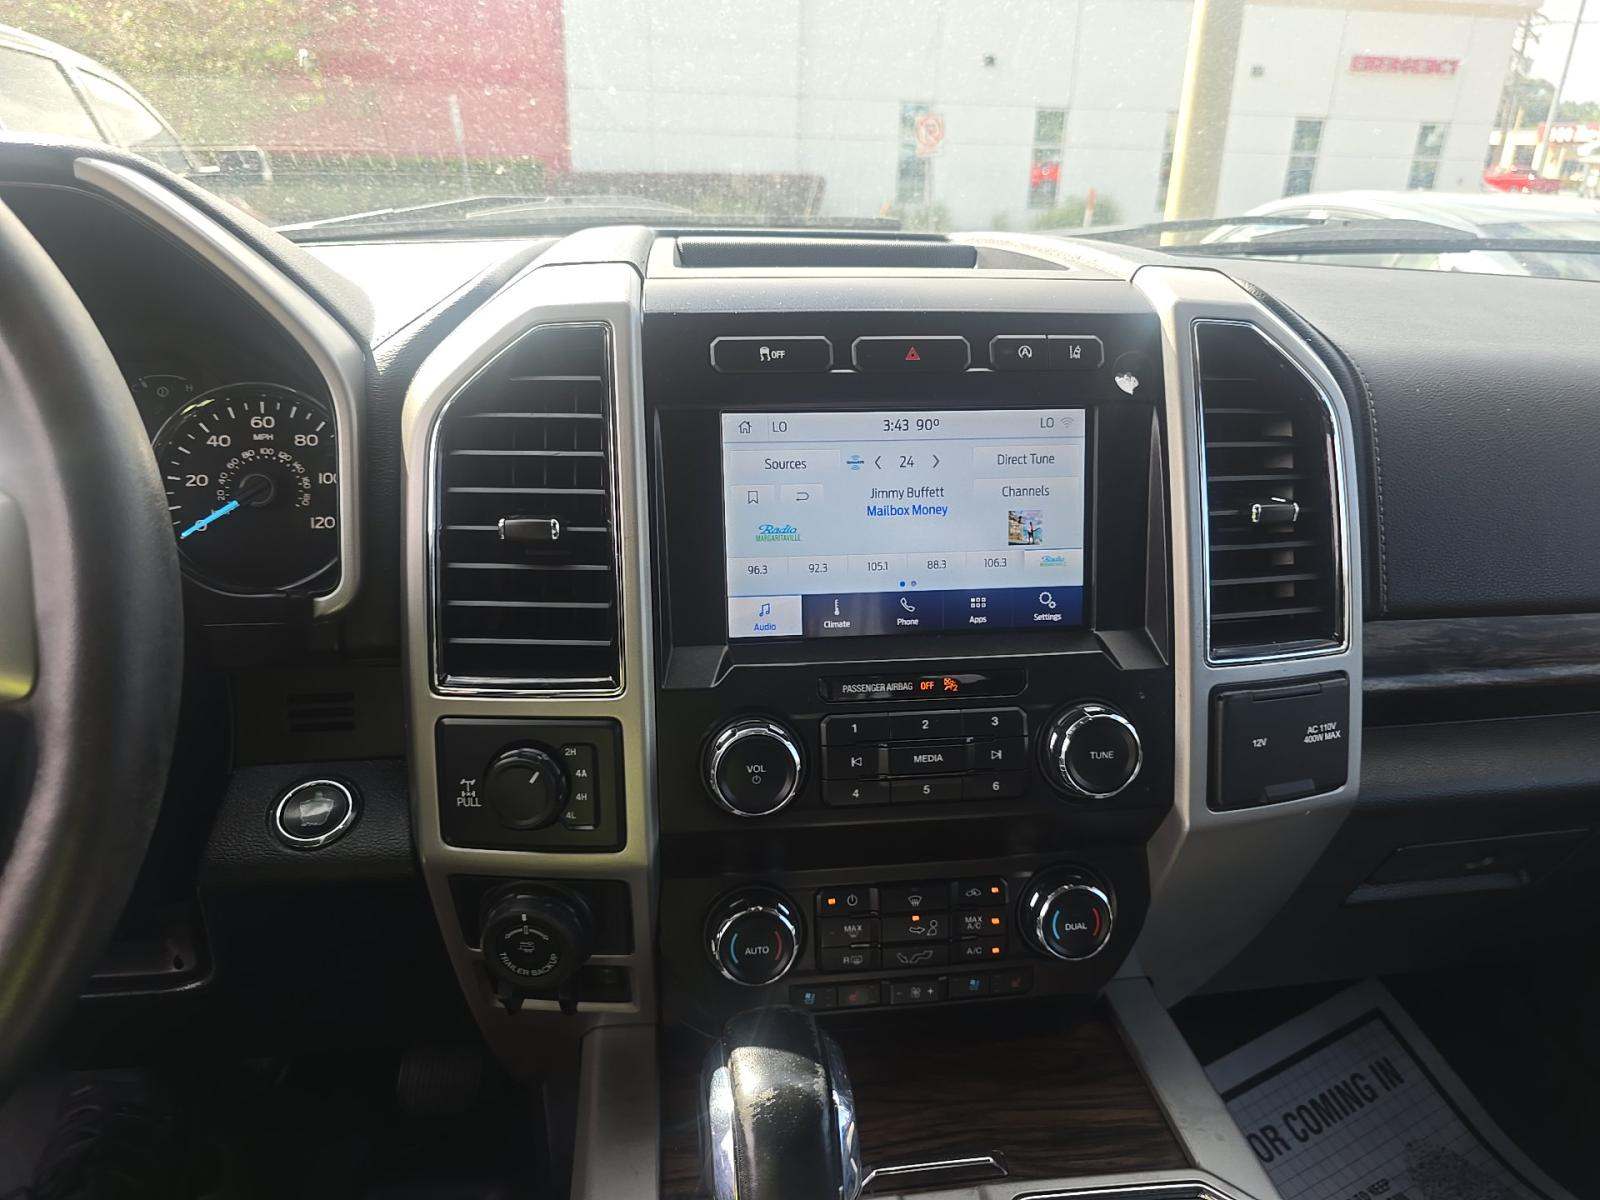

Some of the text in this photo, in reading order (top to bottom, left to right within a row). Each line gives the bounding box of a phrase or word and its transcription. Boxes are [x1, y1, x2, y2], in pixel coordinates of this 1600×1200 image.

[770, 349, 785, 359] OFF
[184, 384, 194, 392] H
[250, 416, 275, 428] 60
[772, 421, 788, 433] LO
[883, 418, 909, 432] 3:43
[1040, 417, 1055, 429] LO
[206, 435, 231, 447] 40
[252, 433, 274, 441] MPH
[294, 434, 319, 447] 80
[241, 449, 255, 459] 80
[260, 447, 275, 455] 100
[278, 451, 293, 461] 120
[226, 457, 239, 469] 60
[764, 457, 807, 470] Sources
[899, 455, 914, 468] 24
[997, 452, 1055, 466] Direct Tune
[185, 474, 209, 487] 20
[218, 472, 228, 485] 40
[216, 489, 225, 501] 20
[870, 486, 945, 501] Jimmy Buffett
[1001, 484, 1050, 497] Channels
[866, 503, 949, 518] Mailbox Money
[310, 517, 336, 529] 120
[758, 523, 798, 534] Radio
[808, 562, 828, 573] 92.3
[867, 561, 889, 572] 105.1
[926, 559, 947, 570] 88.3
[983, 557, 1007, 568] 106.3
[747, 564, 768, 576] 96.3
[896, 616, 919, 627] Phone
[969, 614, 987, 625] Apps
[1033, 611, 1062, 623] Settings
[753, 622, 777, 632] Audio
[823, 618, 851, 629] Climate
[842, 681, 934, 693] PASSENGER AIRBAG OFF
[921, 719, 929, 729] 2
[991, 716, 999, 726] 3
[851, 724, 858, 733] 1
[1307, 722, 1338, 734] AC 110V
[1303, 730, 1342, 744] 400W MAX
[1252, 738, 1268, 748] 12V
[564, 748, 577, 756] 2H
[1089, 750, 1115, 760] TUNE
[913, 753, 944, 764] MEDIA
[575, 769, 587, 778] 4A
[747, 764, 766, 774] VOL
[923, 785, 930, 794] 5
[992, 781, 1000, 791] 6
[575, 792, 588, 801] 4H
[852, 789, 860, 798] 4
[456, 797, 482, 808] PULL
[565, 811, 577, 819] 4L
[843, 924, 862, 932] MAX
[1065, 922, 1088, 931] DUAL
[744, 945, 770, 956] AUTO
[966, 947, 982, 955] A/C
[499, 952, 559, 976] TRAILER BACKUP
[843, 956, 850, 965] R
[1246, 1056, 1405, 1163] OR COMING IN
